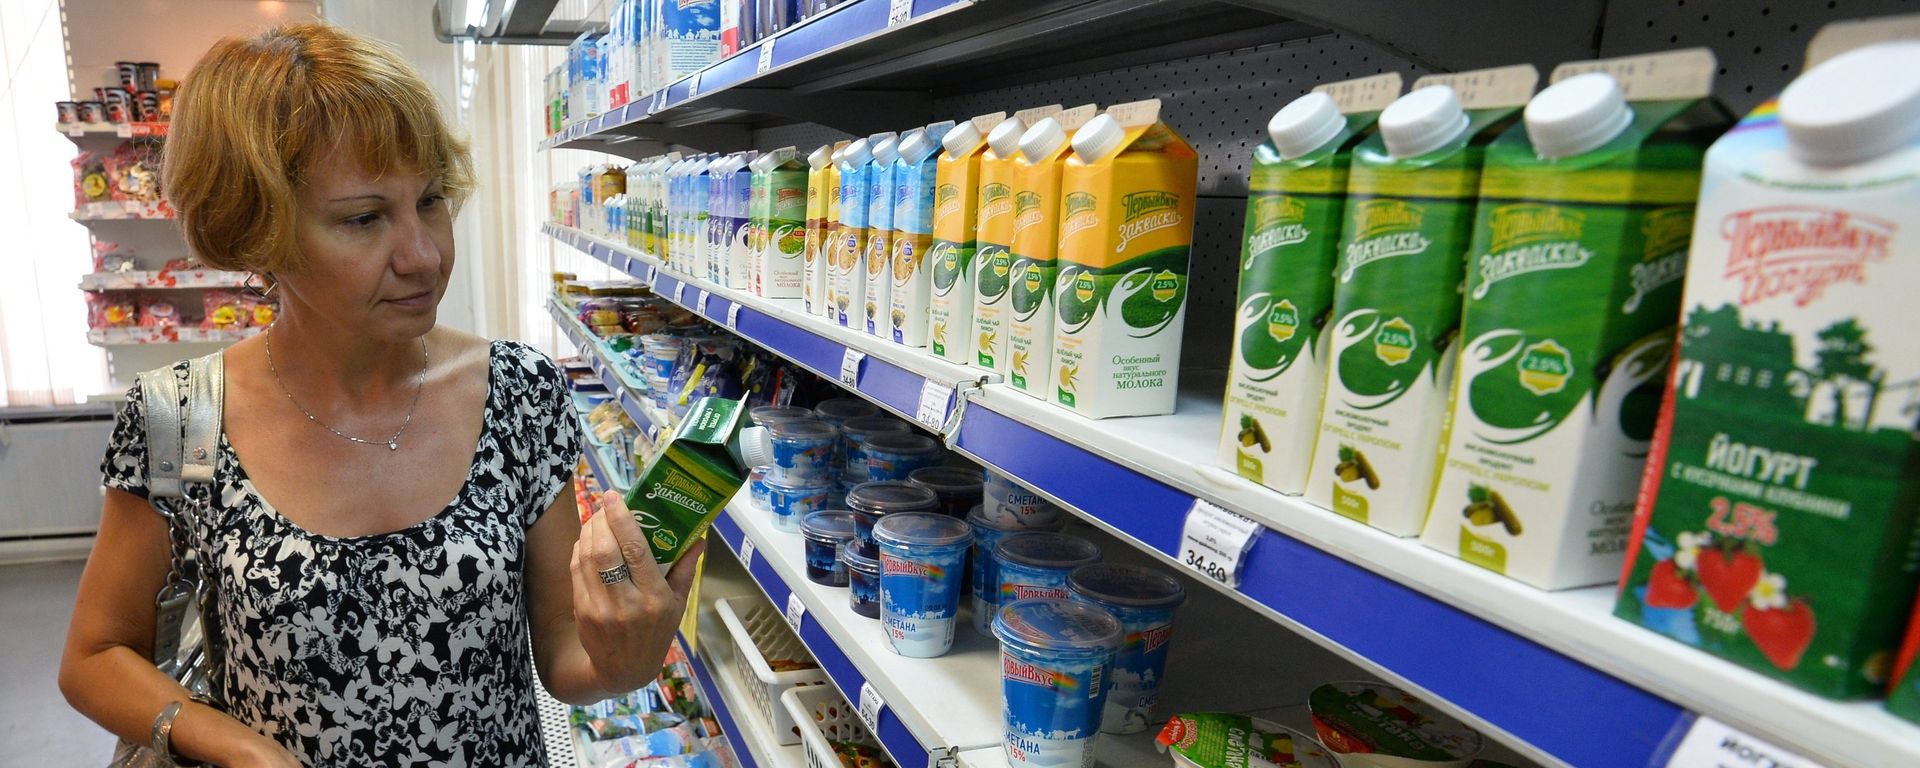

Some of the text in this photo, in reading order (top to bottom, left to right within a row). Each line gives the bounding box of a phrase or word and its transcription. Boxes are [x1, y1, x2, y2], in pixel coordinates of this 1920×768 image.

[1116, 211, 1184, 253] Закваска
[1112, 354, 1161, 366] Особенный
[921, 413, 940, 430] 34-80
[1706, 432, 1818, 489] ЙОГУРТ
[645, 482, 709, 515] Закваска
[1020, 506, 1036, 515] 15%
[1186, 549, 1227, 583] 34-80
[892, 629, 905, 640] 15%
[1009, 745, 1026, 762] 15%
